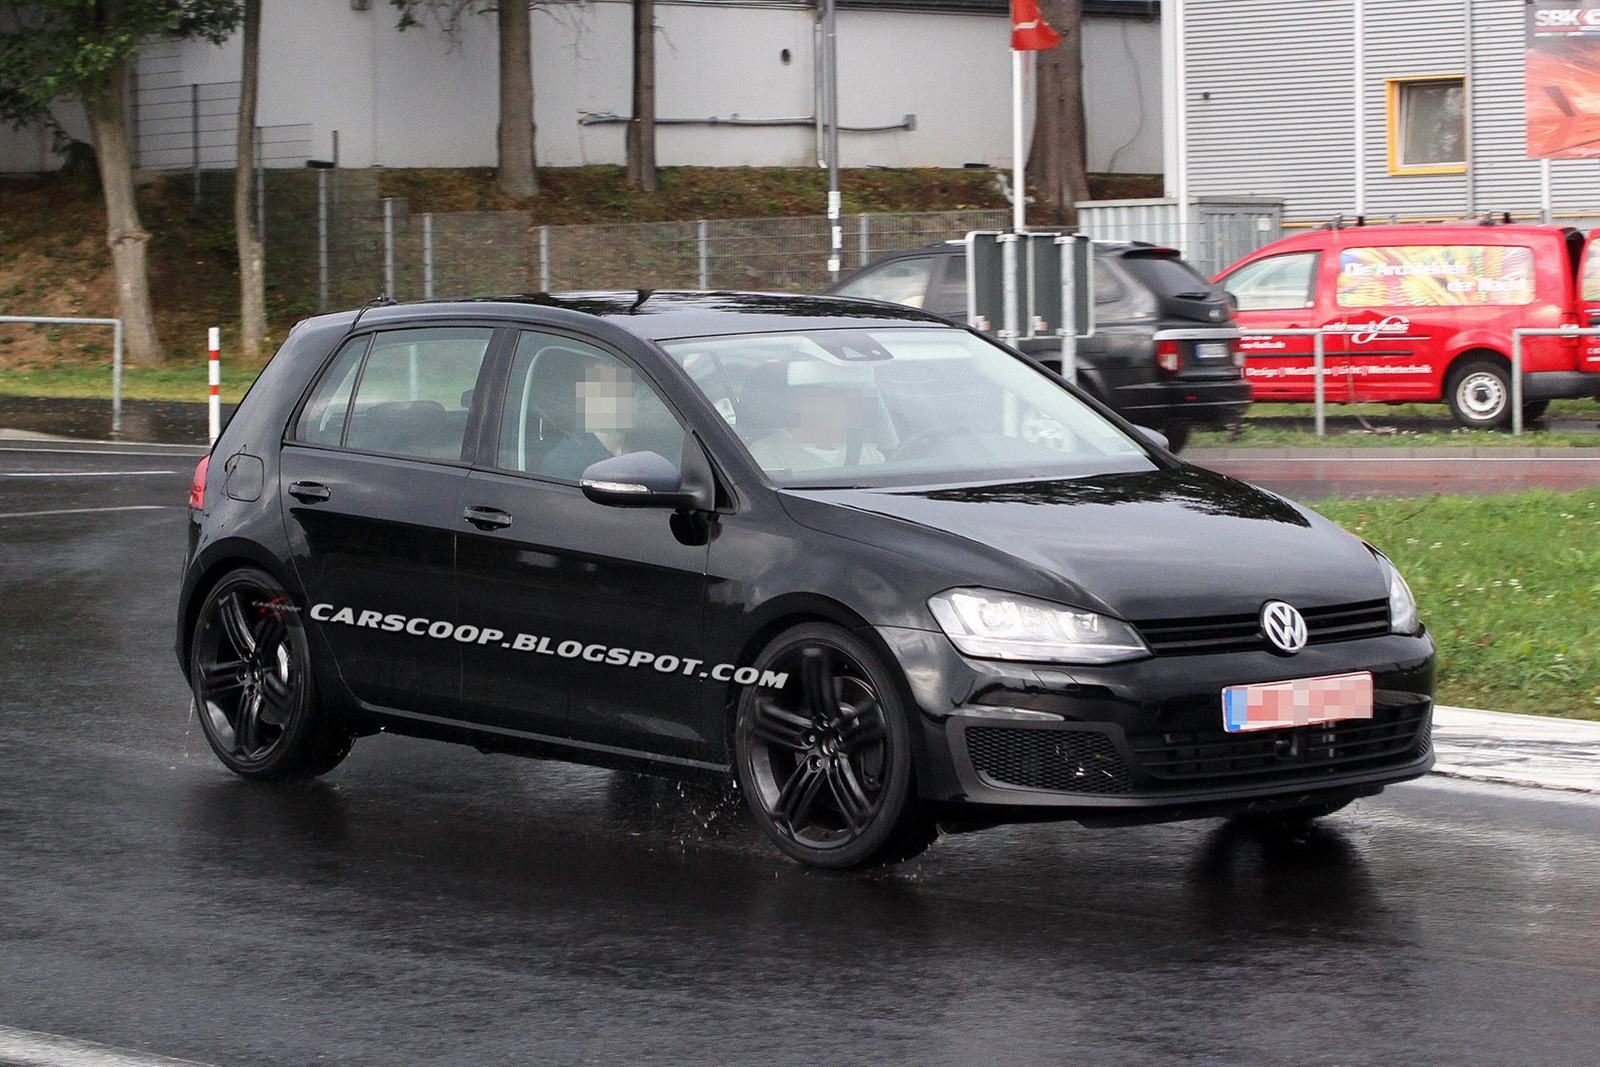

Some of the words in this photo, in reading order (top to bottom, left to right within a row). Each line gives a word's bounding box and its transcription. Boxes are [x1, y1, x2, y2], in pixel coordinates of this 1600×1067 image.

[1344, 262, 1373, 276] Die
[1447, 279, 1476, 292] der
[1264, 602, 1307, 651] VW
